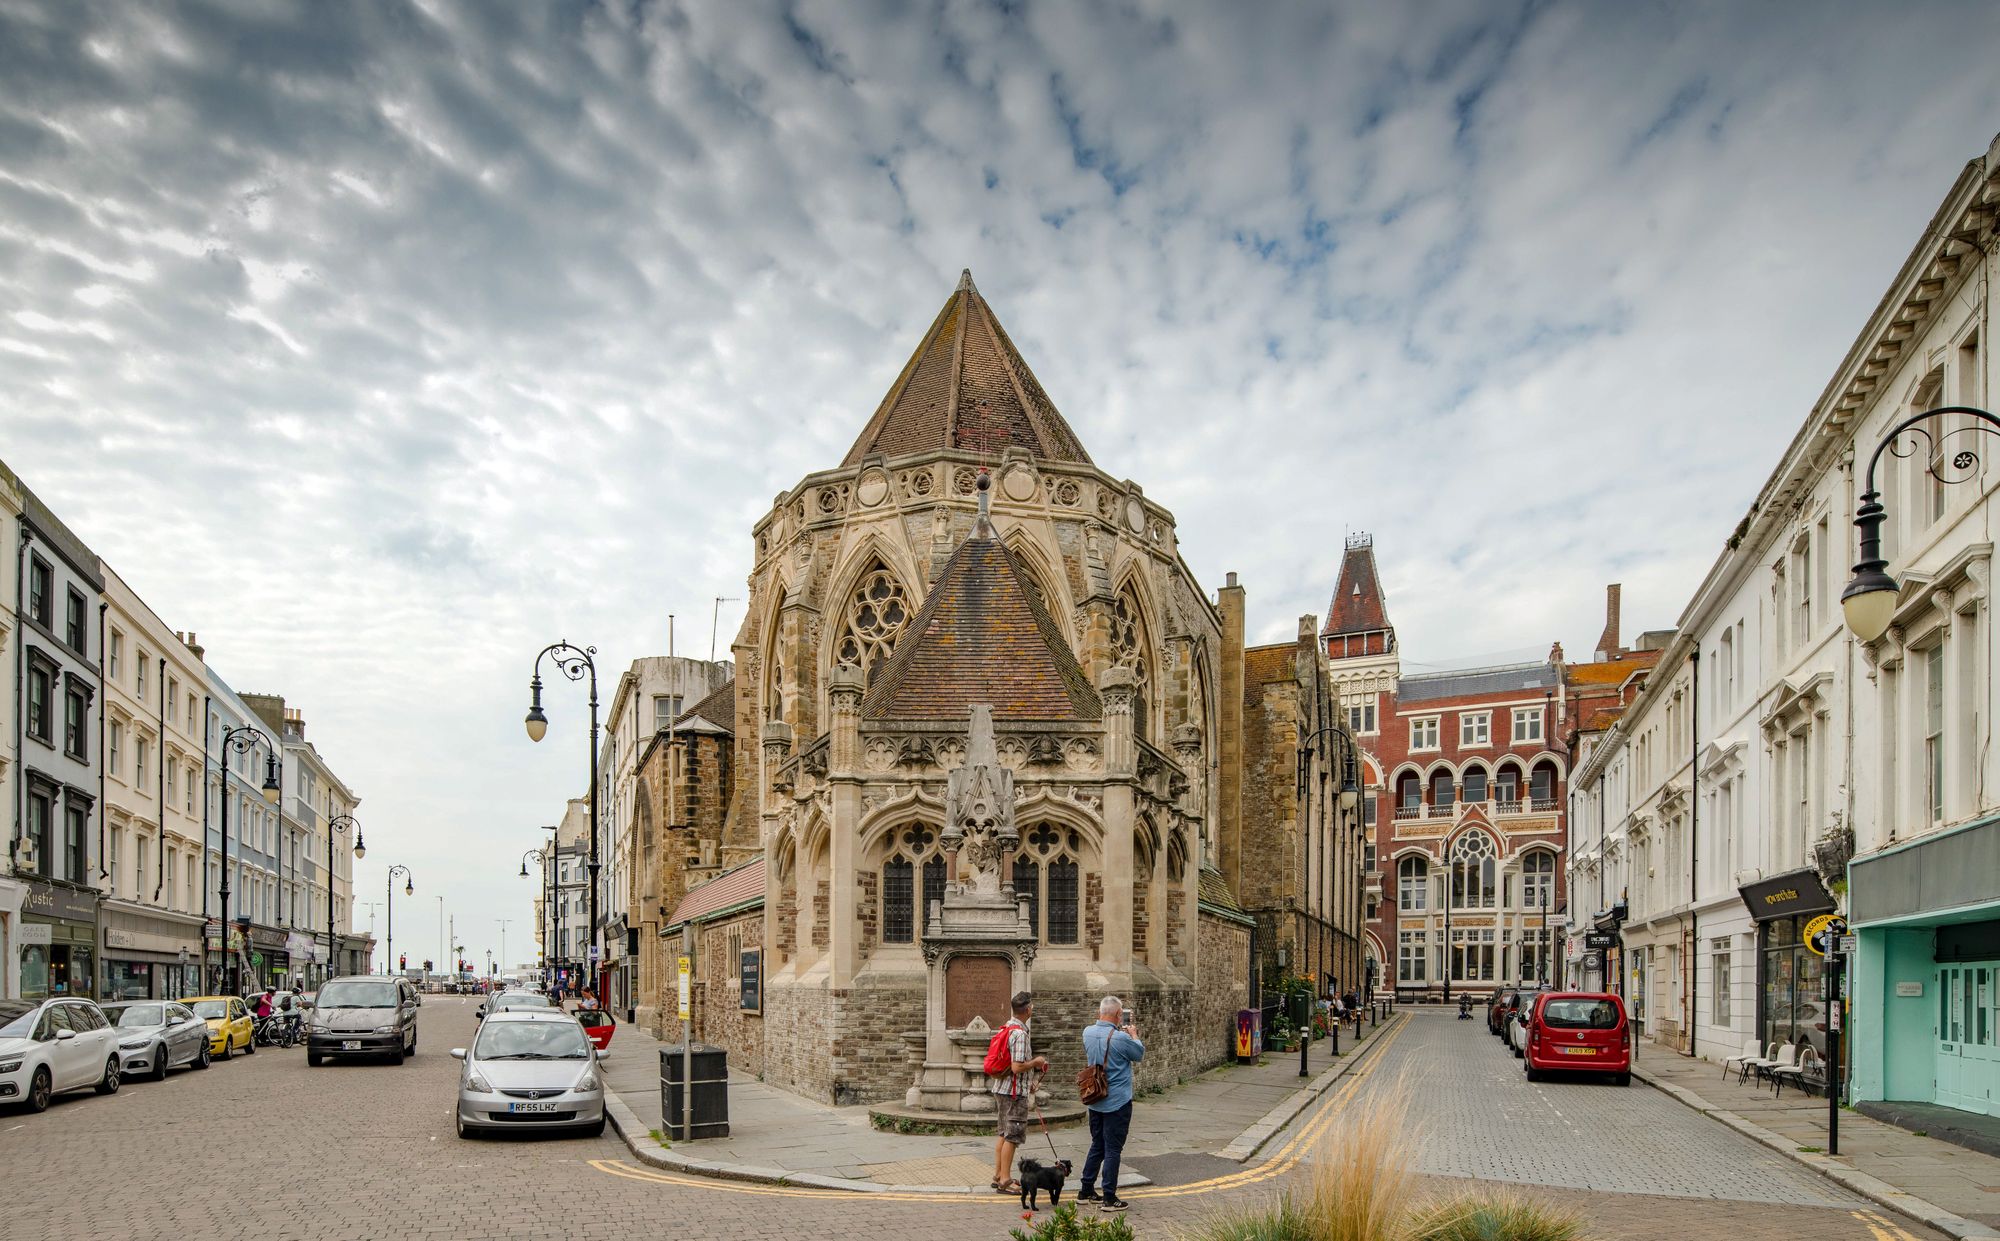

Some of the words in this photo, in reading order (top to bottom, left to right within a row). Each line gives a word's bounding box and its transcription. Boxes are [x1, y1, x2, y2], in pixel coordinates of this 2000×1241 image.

[24, 887, 54, 909] Rustic
[1806, 916, 1828, 937] RECORDS
[515, 1103, 537, 1111] RF55
[539, 1103, 557, 1111] LHZ
